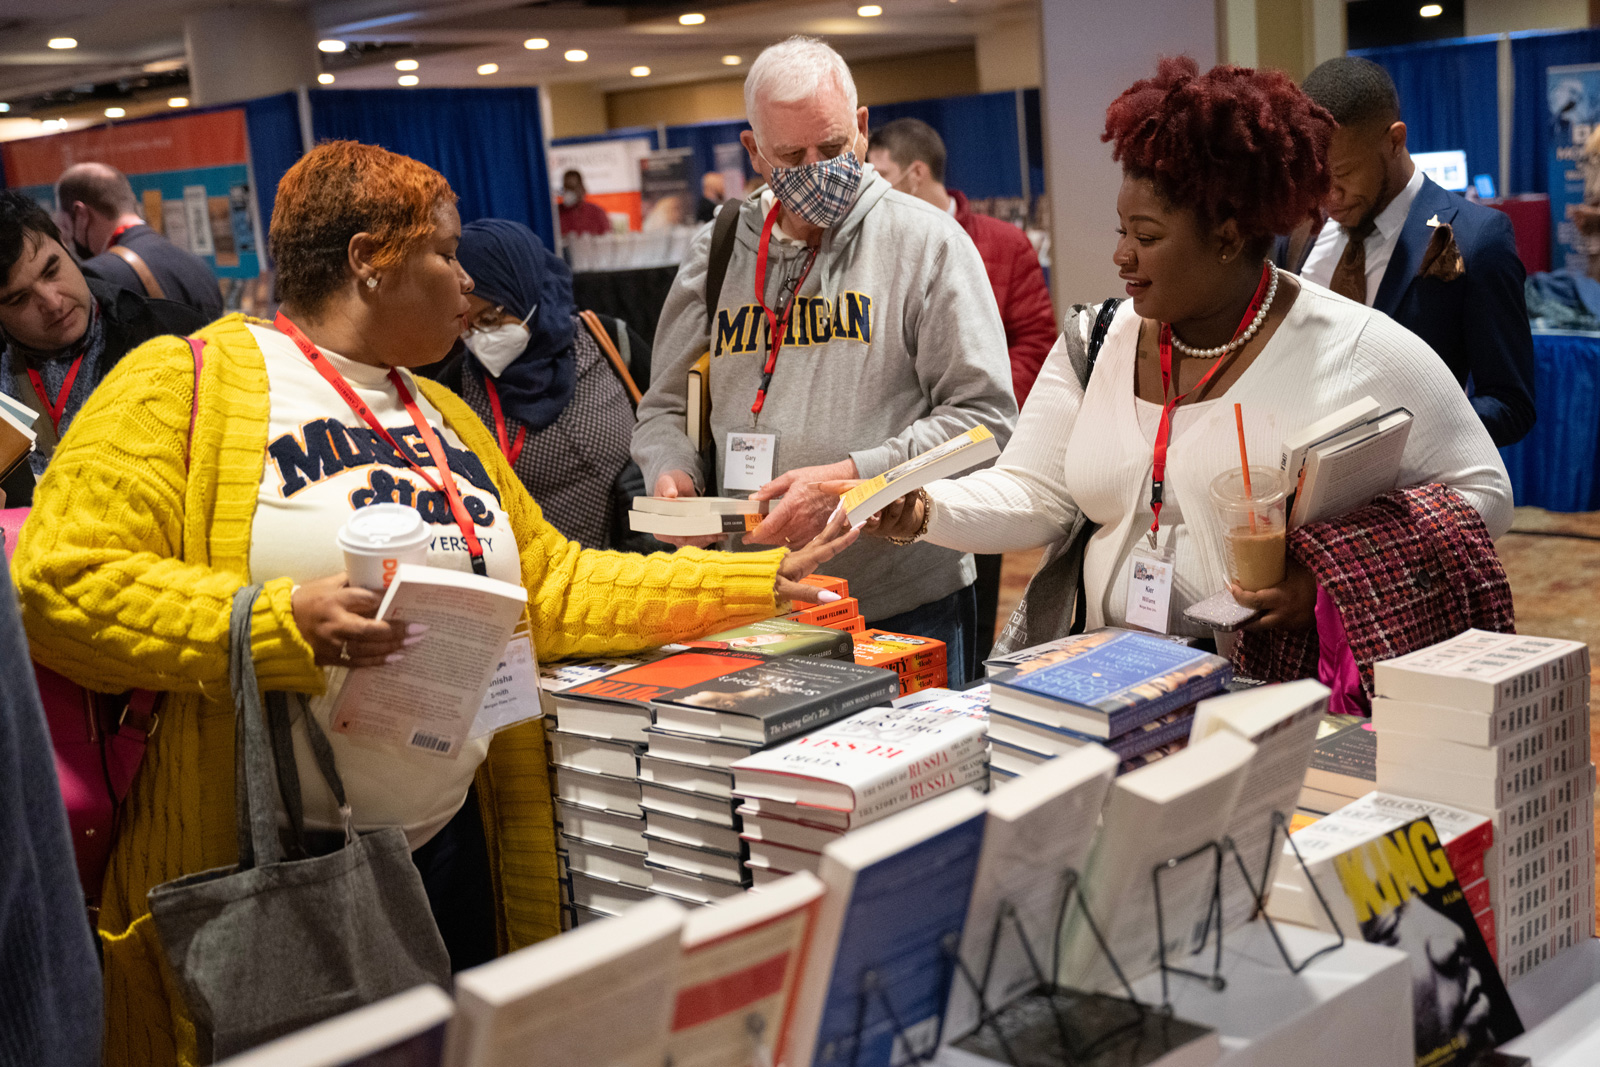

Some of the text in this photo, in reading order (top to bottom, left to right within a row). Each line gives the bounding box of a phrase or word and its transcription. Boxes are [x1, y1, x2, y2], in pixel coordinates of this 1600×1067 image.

[349, 469, 495, 527] Stae
[816, 608, 849, 622] NOAH FELDMAN
[569, 679, 675, 703] PUTIN
[841, 688, 886, 710] JOHN WOOD SWEET
[770, 707, 830, 735] The Sewing Girl's Tale
[863, 750, 949, 797] THE STORY OF RUSSIA
[858, 771, 955, 817] THE STORY OF RUSSIA
[1333, 820, 1456, 923] KING
